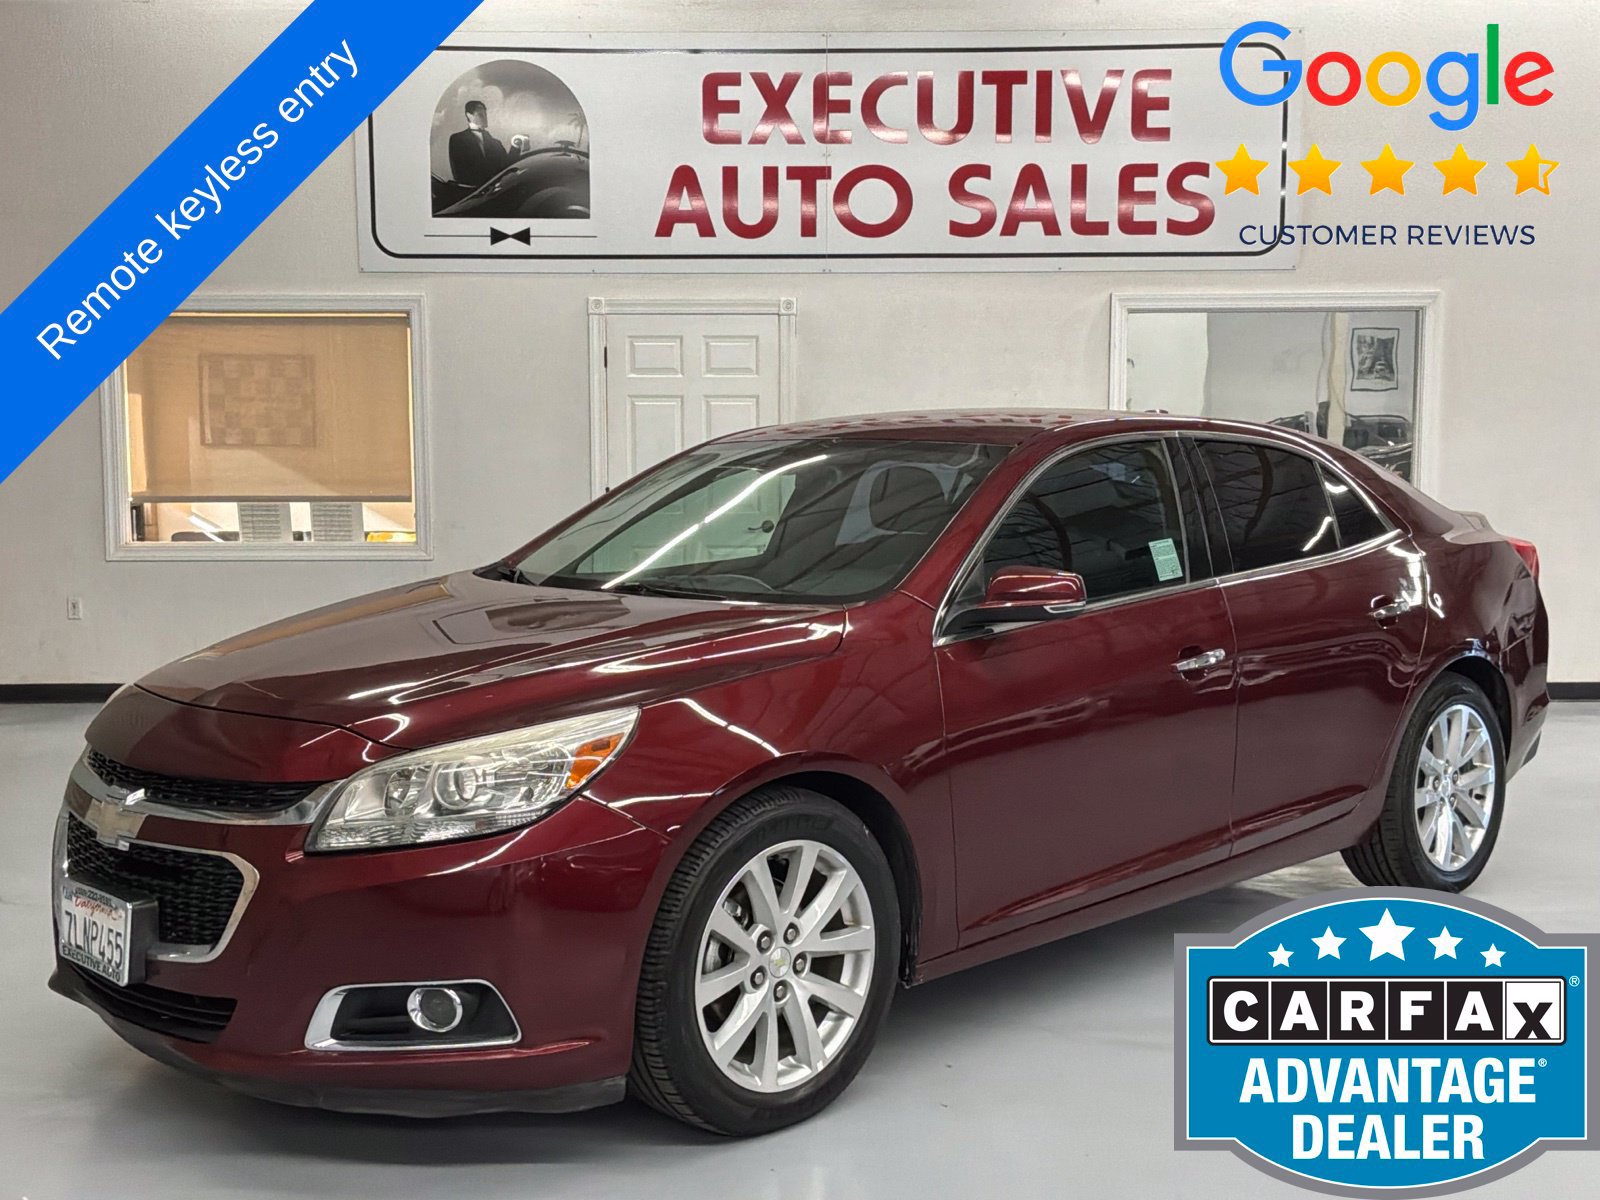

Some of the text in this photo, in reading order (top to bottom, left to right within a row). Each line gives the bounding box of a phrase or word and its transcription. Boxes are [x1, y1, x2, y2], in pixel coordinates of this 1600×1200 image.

[701, 68, 1173, 145] EXECUTIVE
[654, 161, 1216, 239] AUTO SALES
[62, 945, 101, 971] EXECUTIVE
[64, 910, 123, 970] 7LNP455
